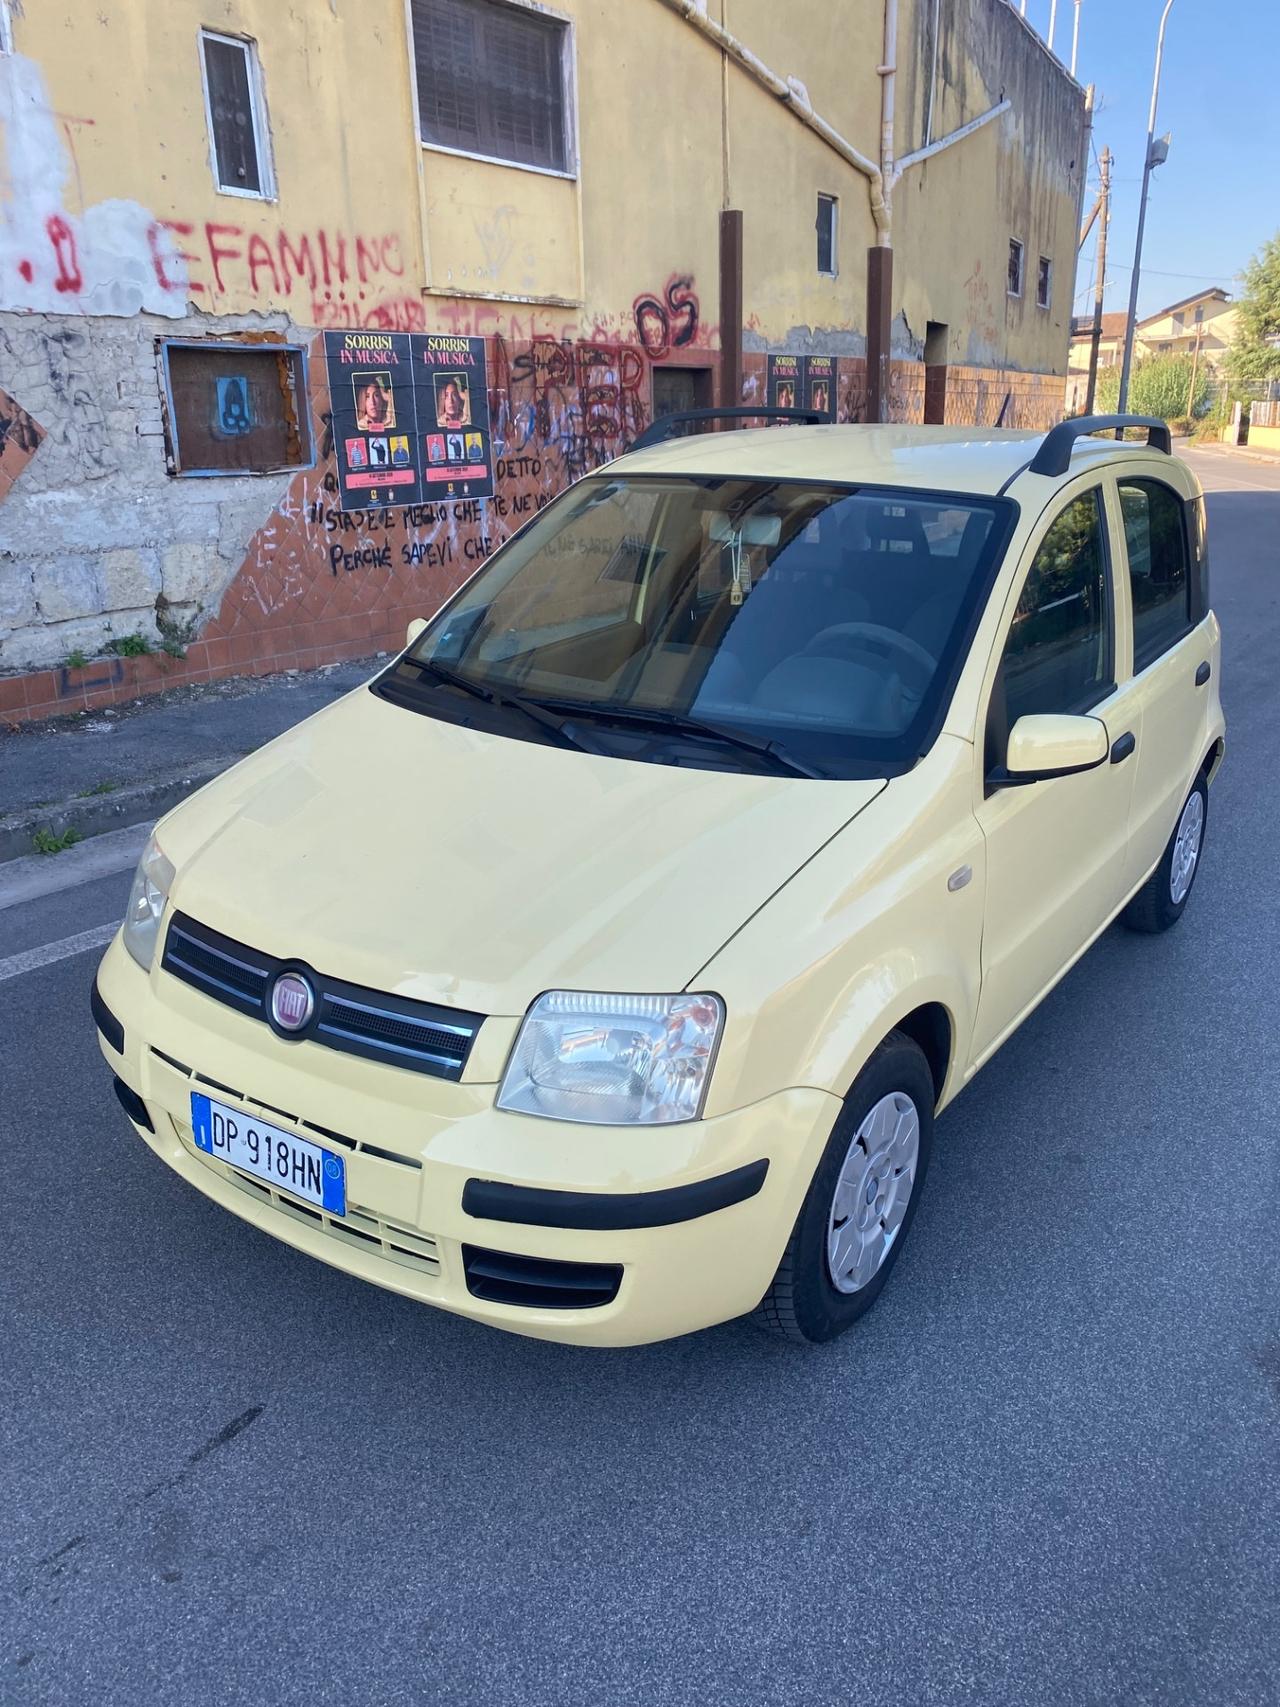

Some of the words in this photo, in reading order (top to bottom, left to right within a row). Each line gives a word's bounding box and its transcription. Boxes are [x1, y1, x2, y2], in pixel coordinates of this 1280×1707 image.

[344, 334, 393, 350] SORRISI
[427, 337, 470, 352] SORRISI
[340, 349, 353, 364] IN
[356, 350, 399, 364] MUSICA
[424, 351, 437, 365] IN
[437, 351, 475, 366] MUSICA
[496, 456, 541, 481] DETTO
[454, 500, 483, 524] CHE
[513, 493, 532, 515] NE
[464, 536, 494, 560] CHE
[213, 1112, 238, 1152] DP
[247, 1129, 321, 1195] 918HN
